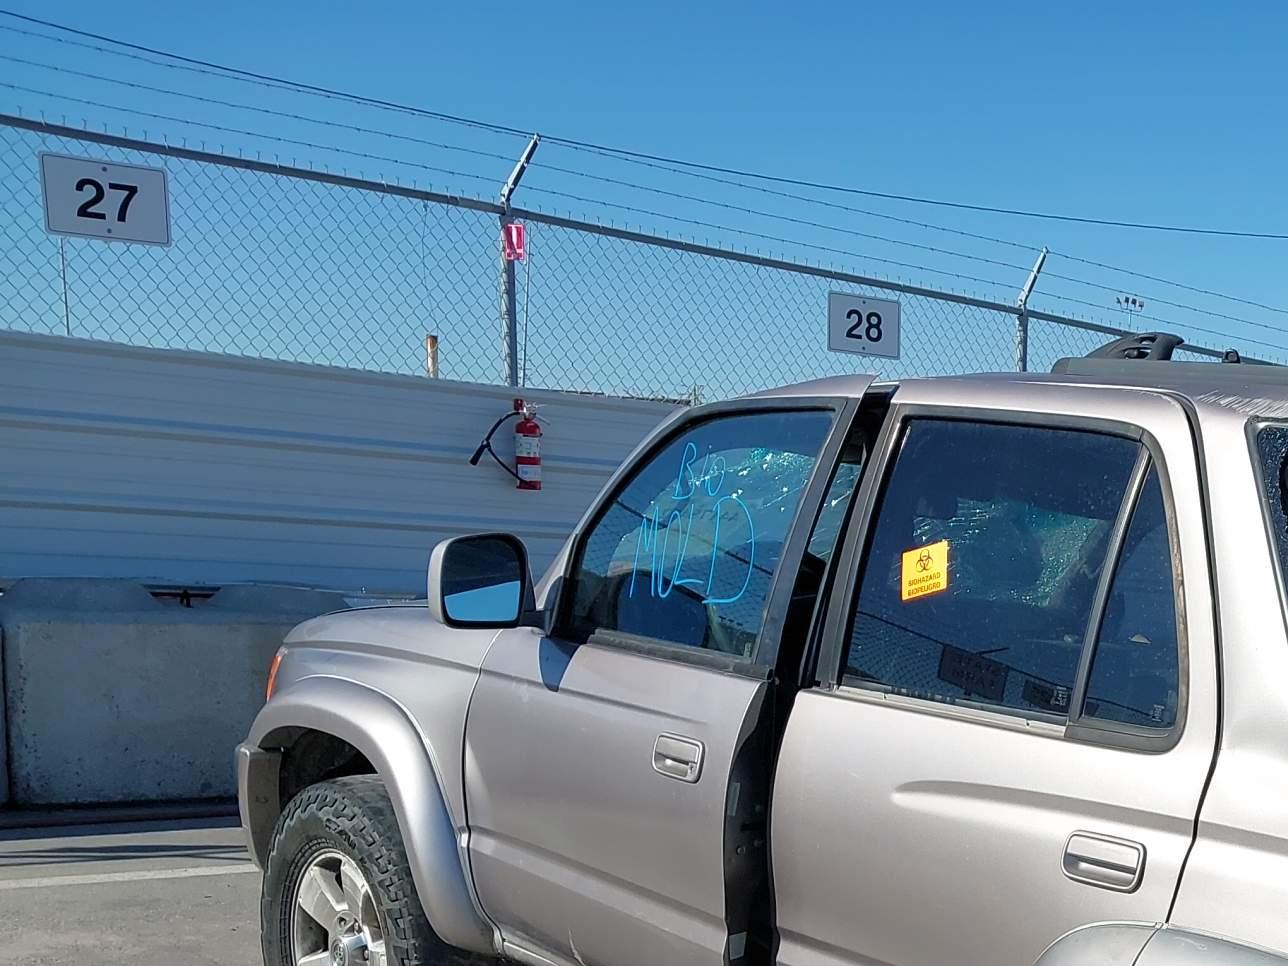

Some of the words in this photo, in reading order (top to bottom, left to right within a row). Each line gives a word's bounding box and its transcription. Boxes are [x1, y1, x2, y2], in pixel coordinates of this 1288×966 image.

[75, 178, 138, 222] 27
[846, 308, 883, 343] 28
[629, 496, 755, 604] MOLD
[907, 571, 942, 588] BIOHAZARD
